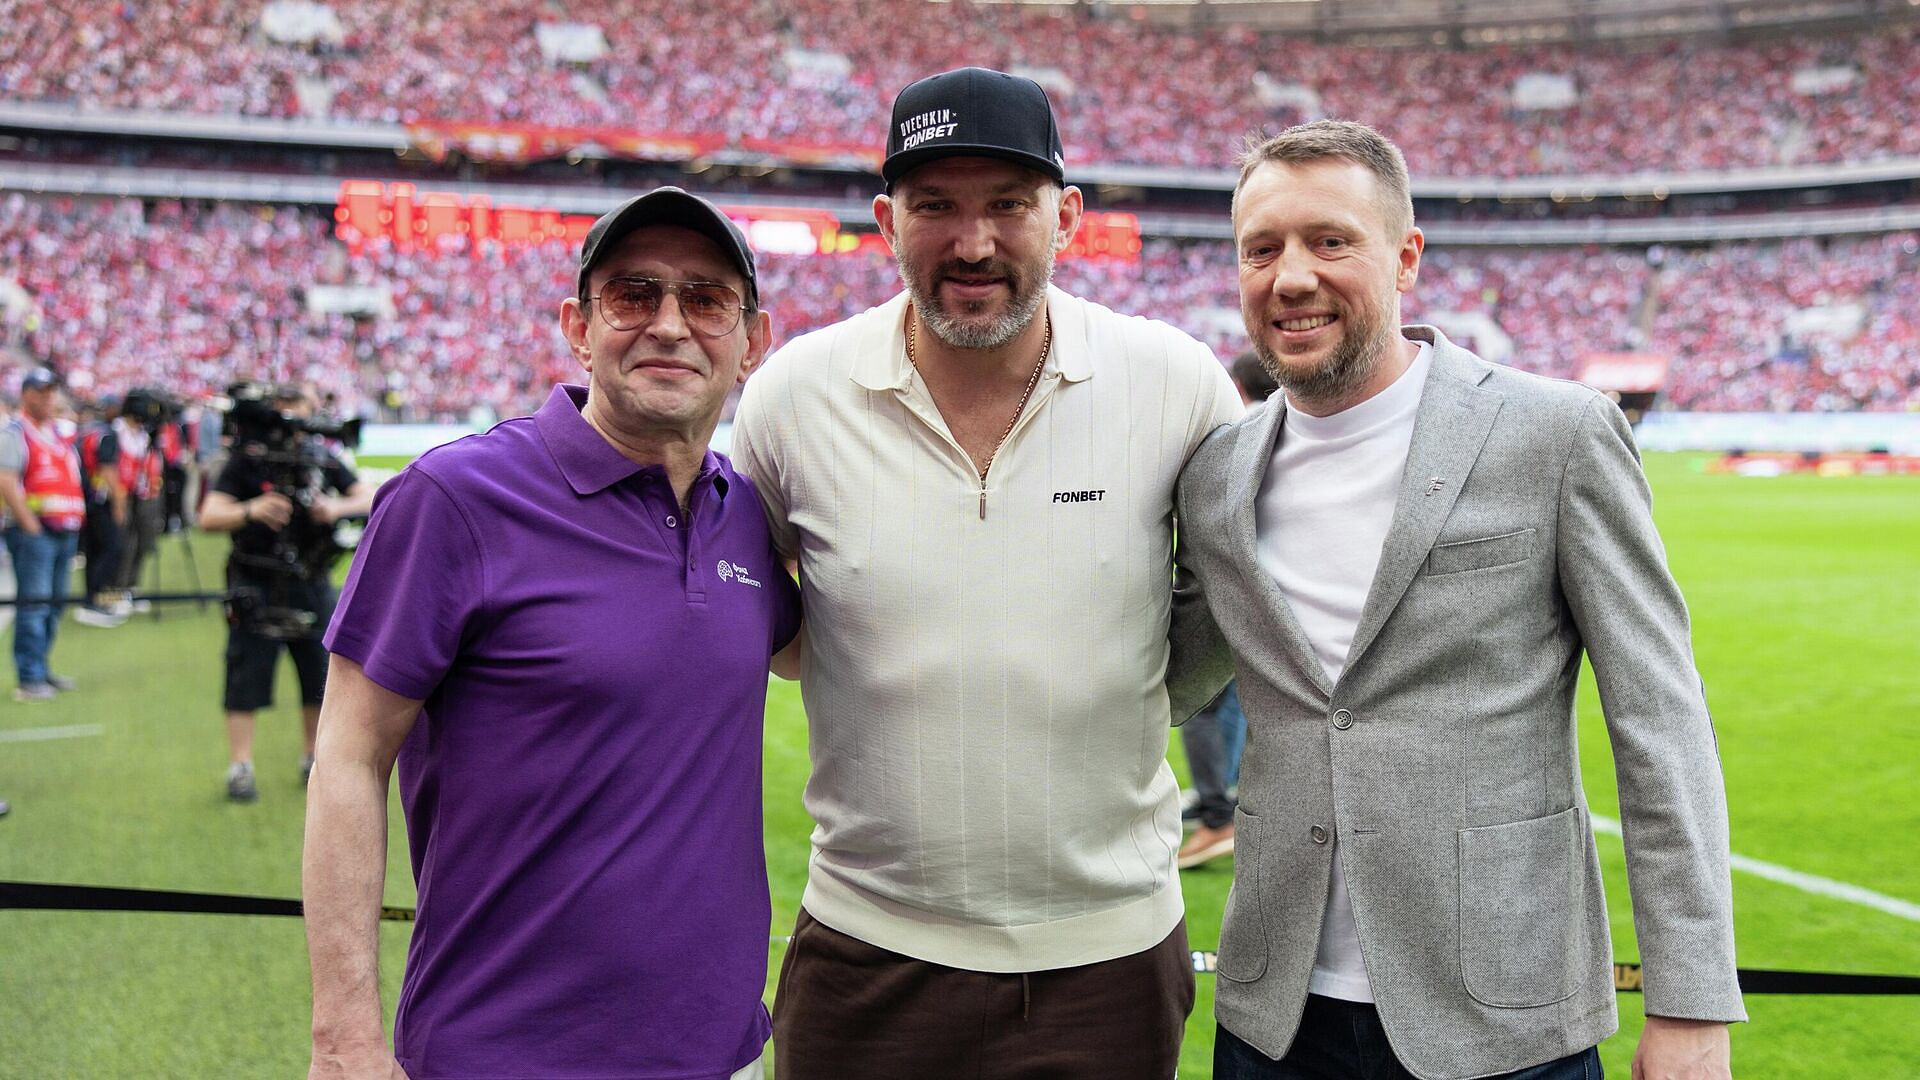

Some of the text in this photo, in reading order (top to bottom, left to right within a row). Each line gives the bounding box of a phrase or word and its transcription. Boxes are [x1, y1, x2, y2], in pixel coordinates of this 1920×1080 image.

[900, 108, 950, 137] OVECHKIN
[903, 122, 959, 151] FONBET
[1052, 489, 1106, 503] FONBET
